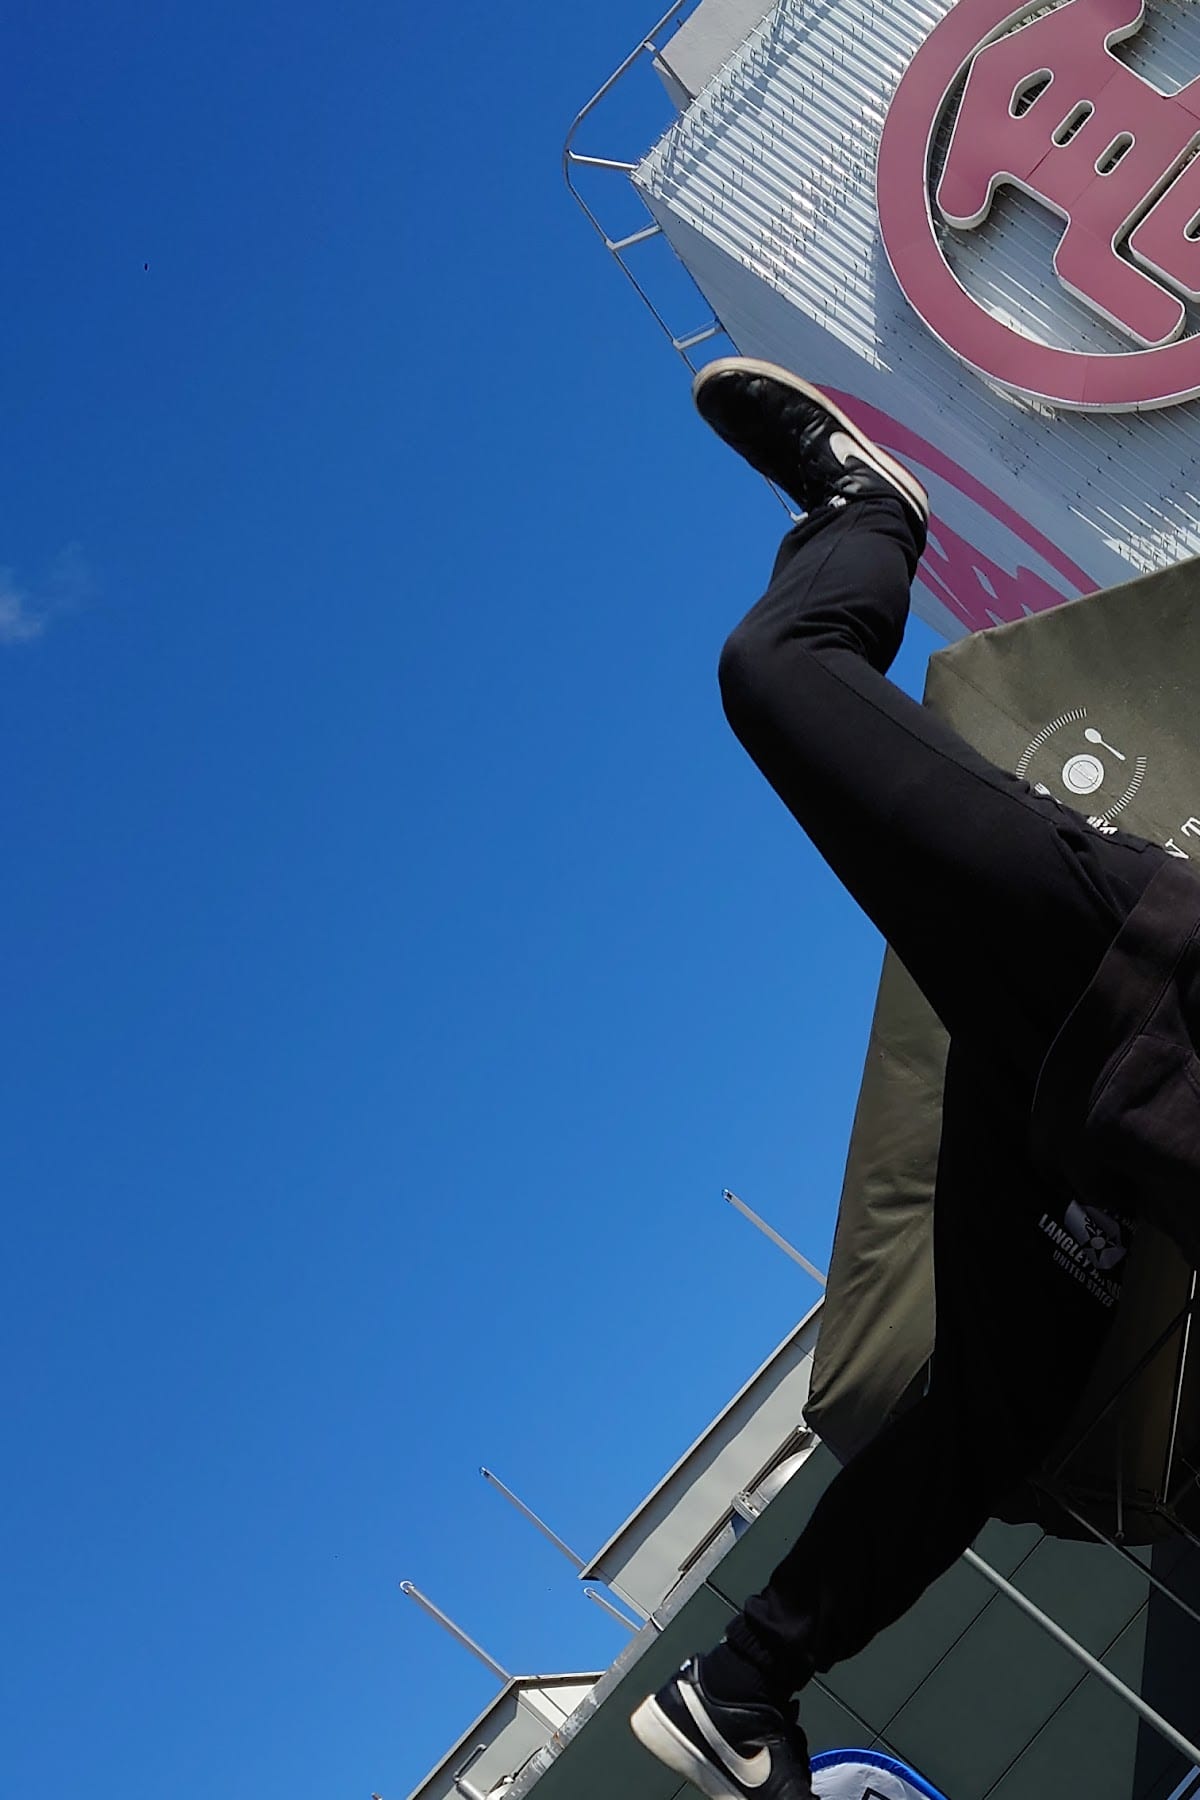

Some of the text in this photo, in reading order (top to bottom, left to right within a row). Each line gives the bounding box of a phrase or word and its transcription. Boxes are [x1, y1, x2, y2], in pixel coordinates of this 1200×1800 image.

[1038, 1213, 1091, 1268] LANGLEY
[1053, 1249, 1086, 1284] UNITED
[1086, 1278, 1115, 1308] STATES
